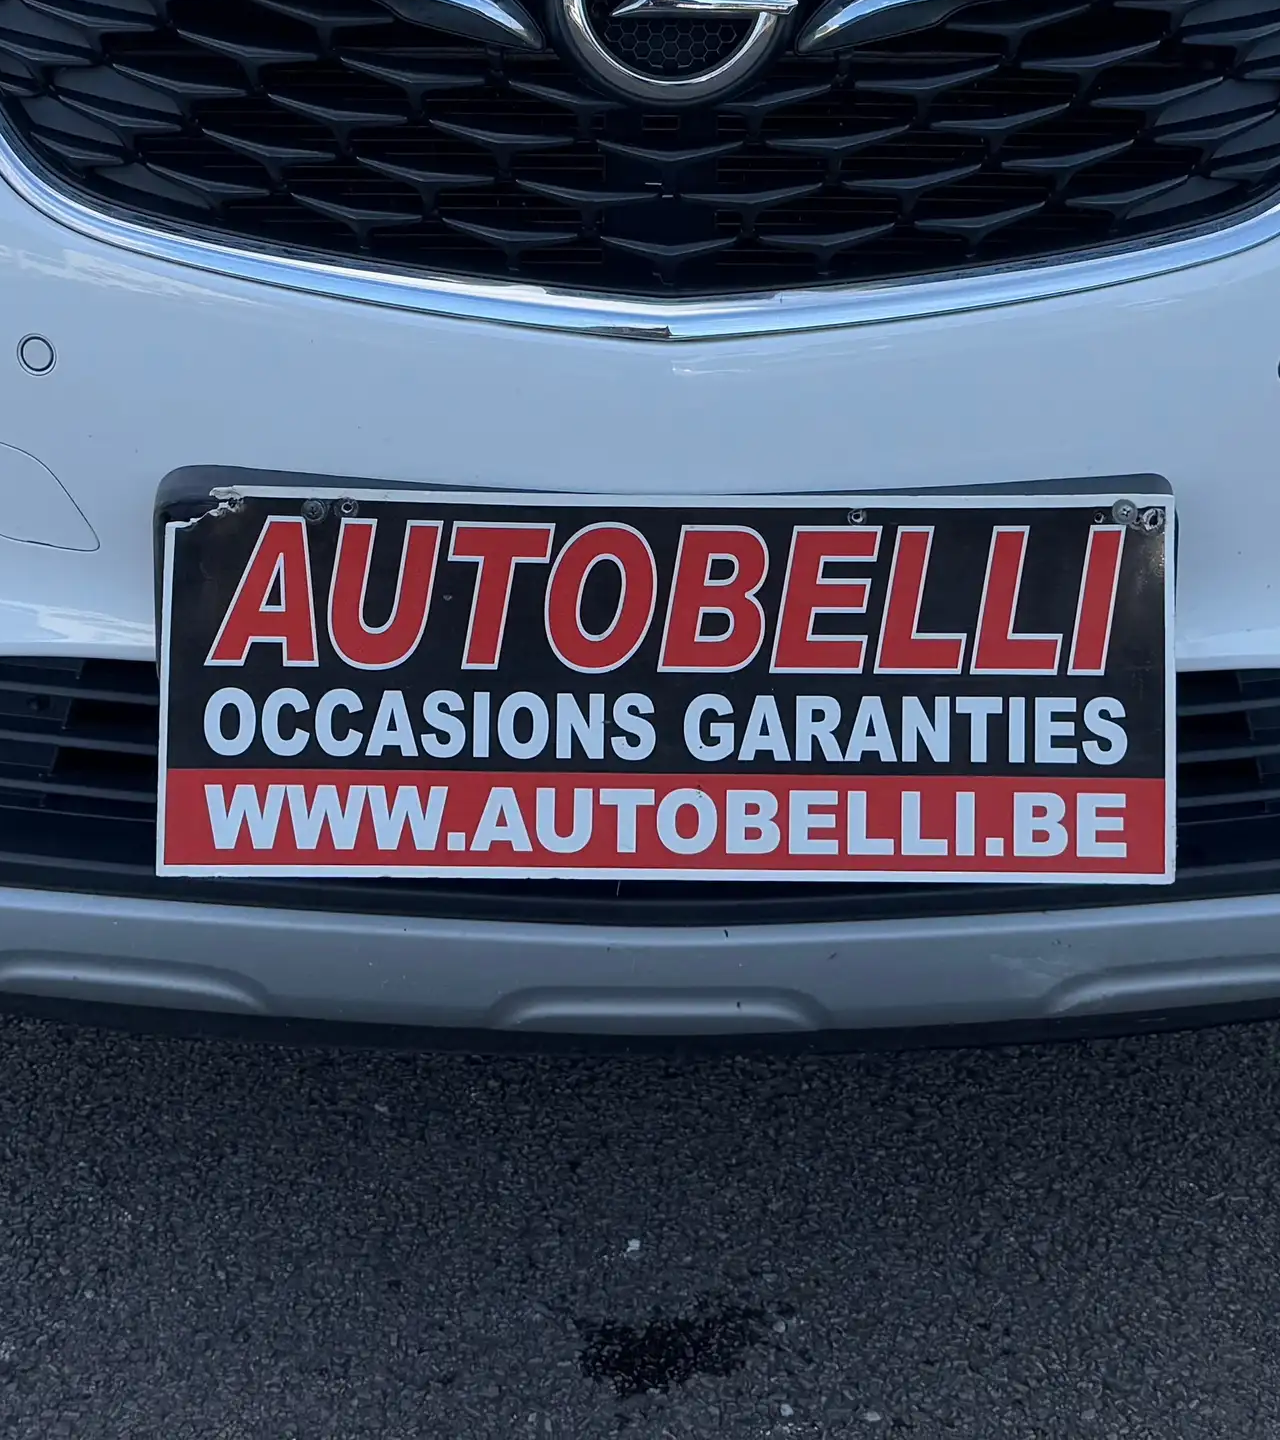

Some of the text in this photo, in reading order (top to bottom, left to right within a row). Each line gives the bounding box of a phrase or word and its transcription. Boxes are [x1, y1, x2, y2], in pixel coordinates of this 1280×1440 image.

[203, 514, 1127, 676] AUTOBELLI
[203, 687, 1128, 765] OCCASIONS GARANTIES
[203, 783, 1128, 859] WWW.AUTOBELLI.BE
